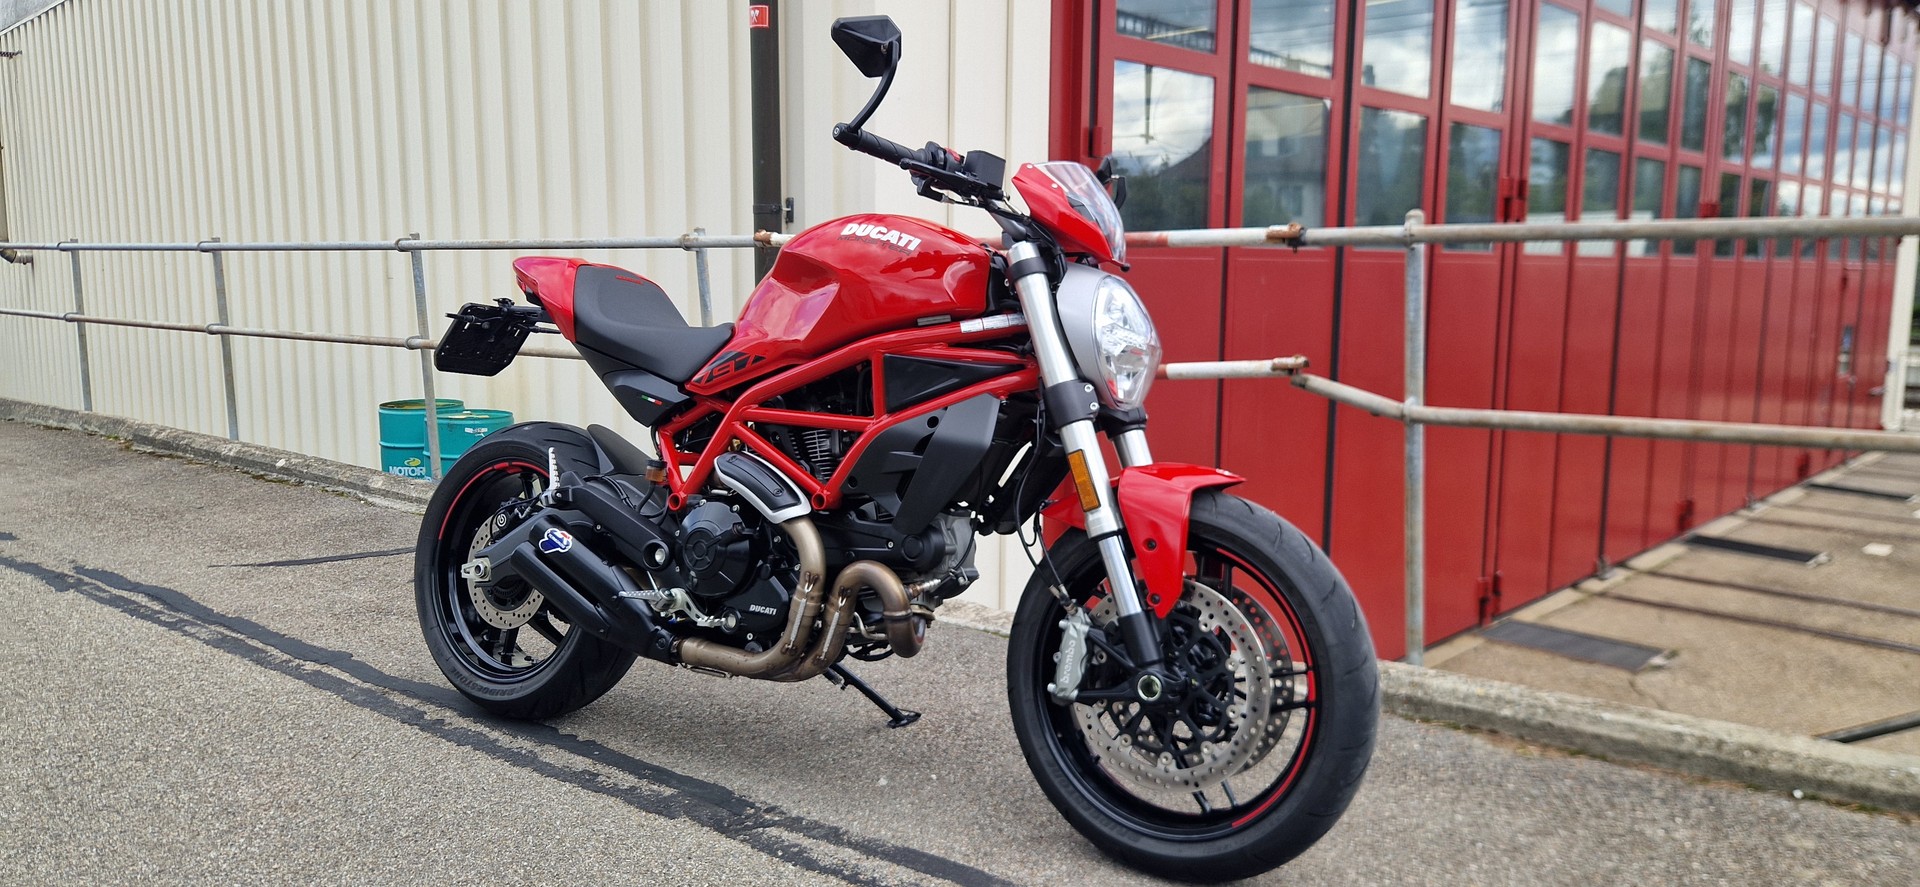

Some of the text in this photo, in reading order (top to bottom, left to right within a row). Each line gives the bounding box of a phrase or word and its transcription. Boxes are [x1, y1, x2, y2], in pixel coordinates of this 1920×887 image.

[838, 234, 913, 256] MONSTER
[840, 223, 922, 251] DUCATI
[749, 604, 777, 616] DUCATI
[1060, 640, 1076, 683] brembo
